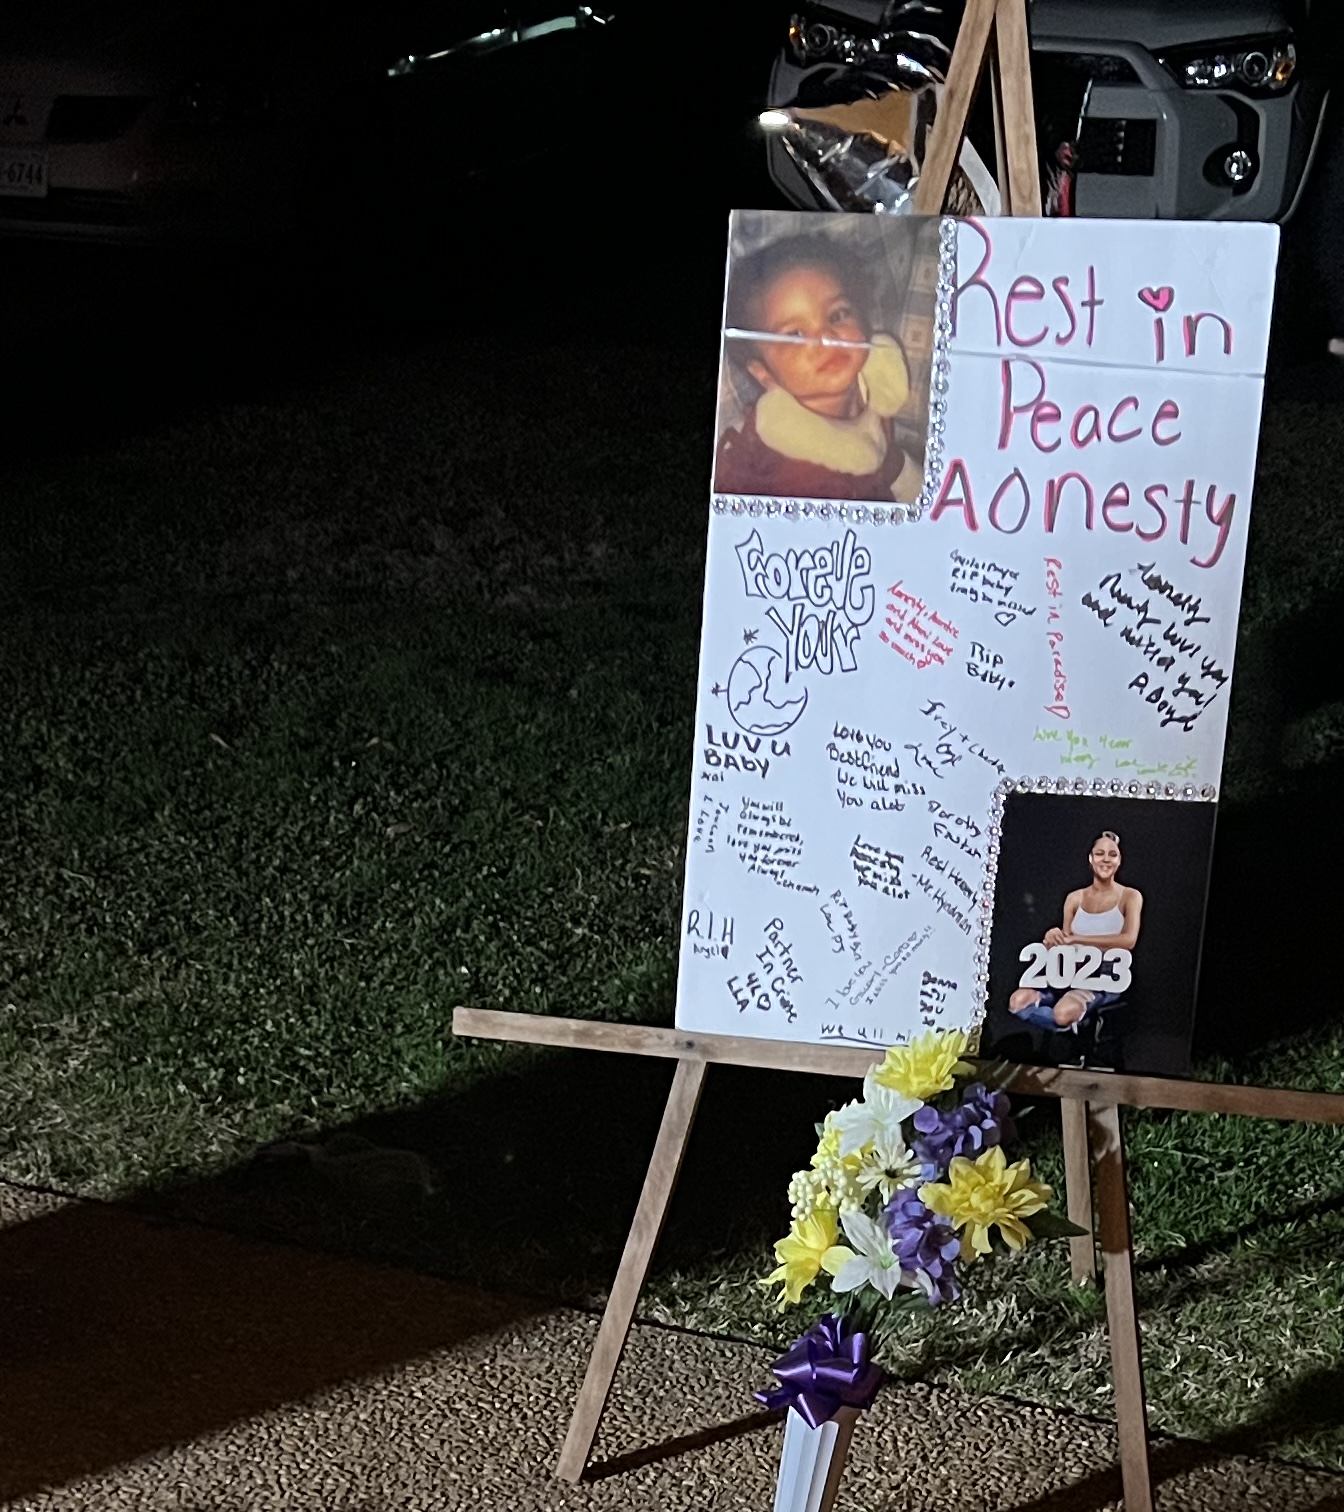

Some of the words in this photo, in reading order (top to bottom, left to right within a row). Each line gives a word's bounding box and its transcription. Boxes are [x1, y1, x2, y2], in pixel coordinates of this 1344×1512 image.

[951, 216, 1104, 348] Rest
[1138, 286, 1232, 363] in
[998, 355, 1182, 453] Peace
[930, 458, 1236, 568] Aonesty
[706, 723, 761, 754] LUV
[1018, 942, 1133, 993] 2023
